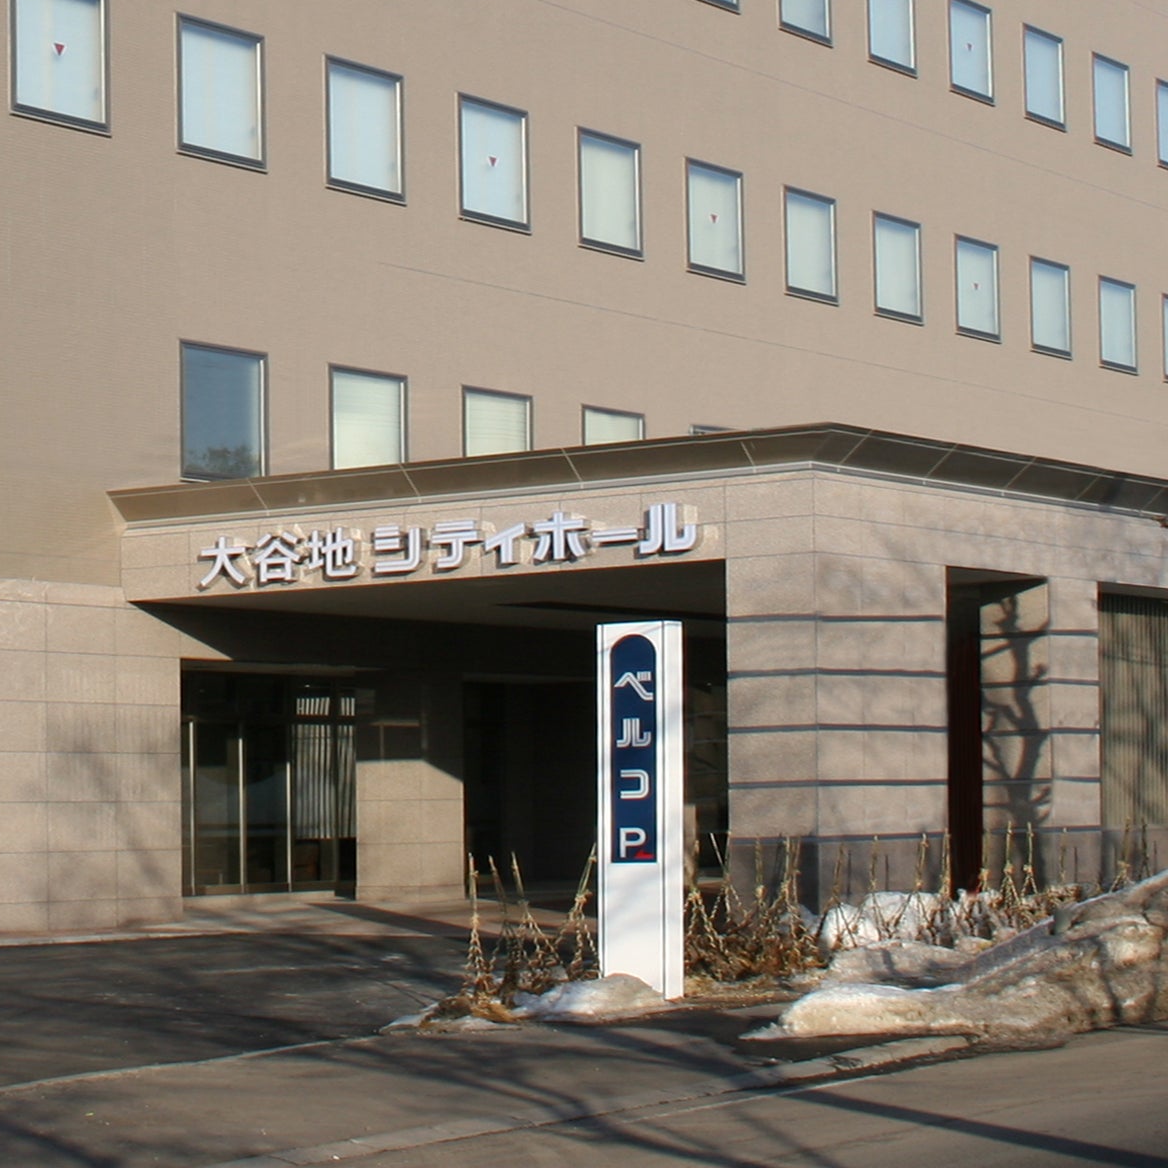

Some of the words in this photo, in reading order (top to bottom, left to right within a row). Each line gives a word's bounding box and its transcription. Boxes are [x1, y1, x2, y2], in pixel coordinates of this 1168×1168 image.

[198, 502, 698, 589] 大谷地シティホール
[613, 671, 655, 800] ベルコ
[618, 827, 647, 859] P
